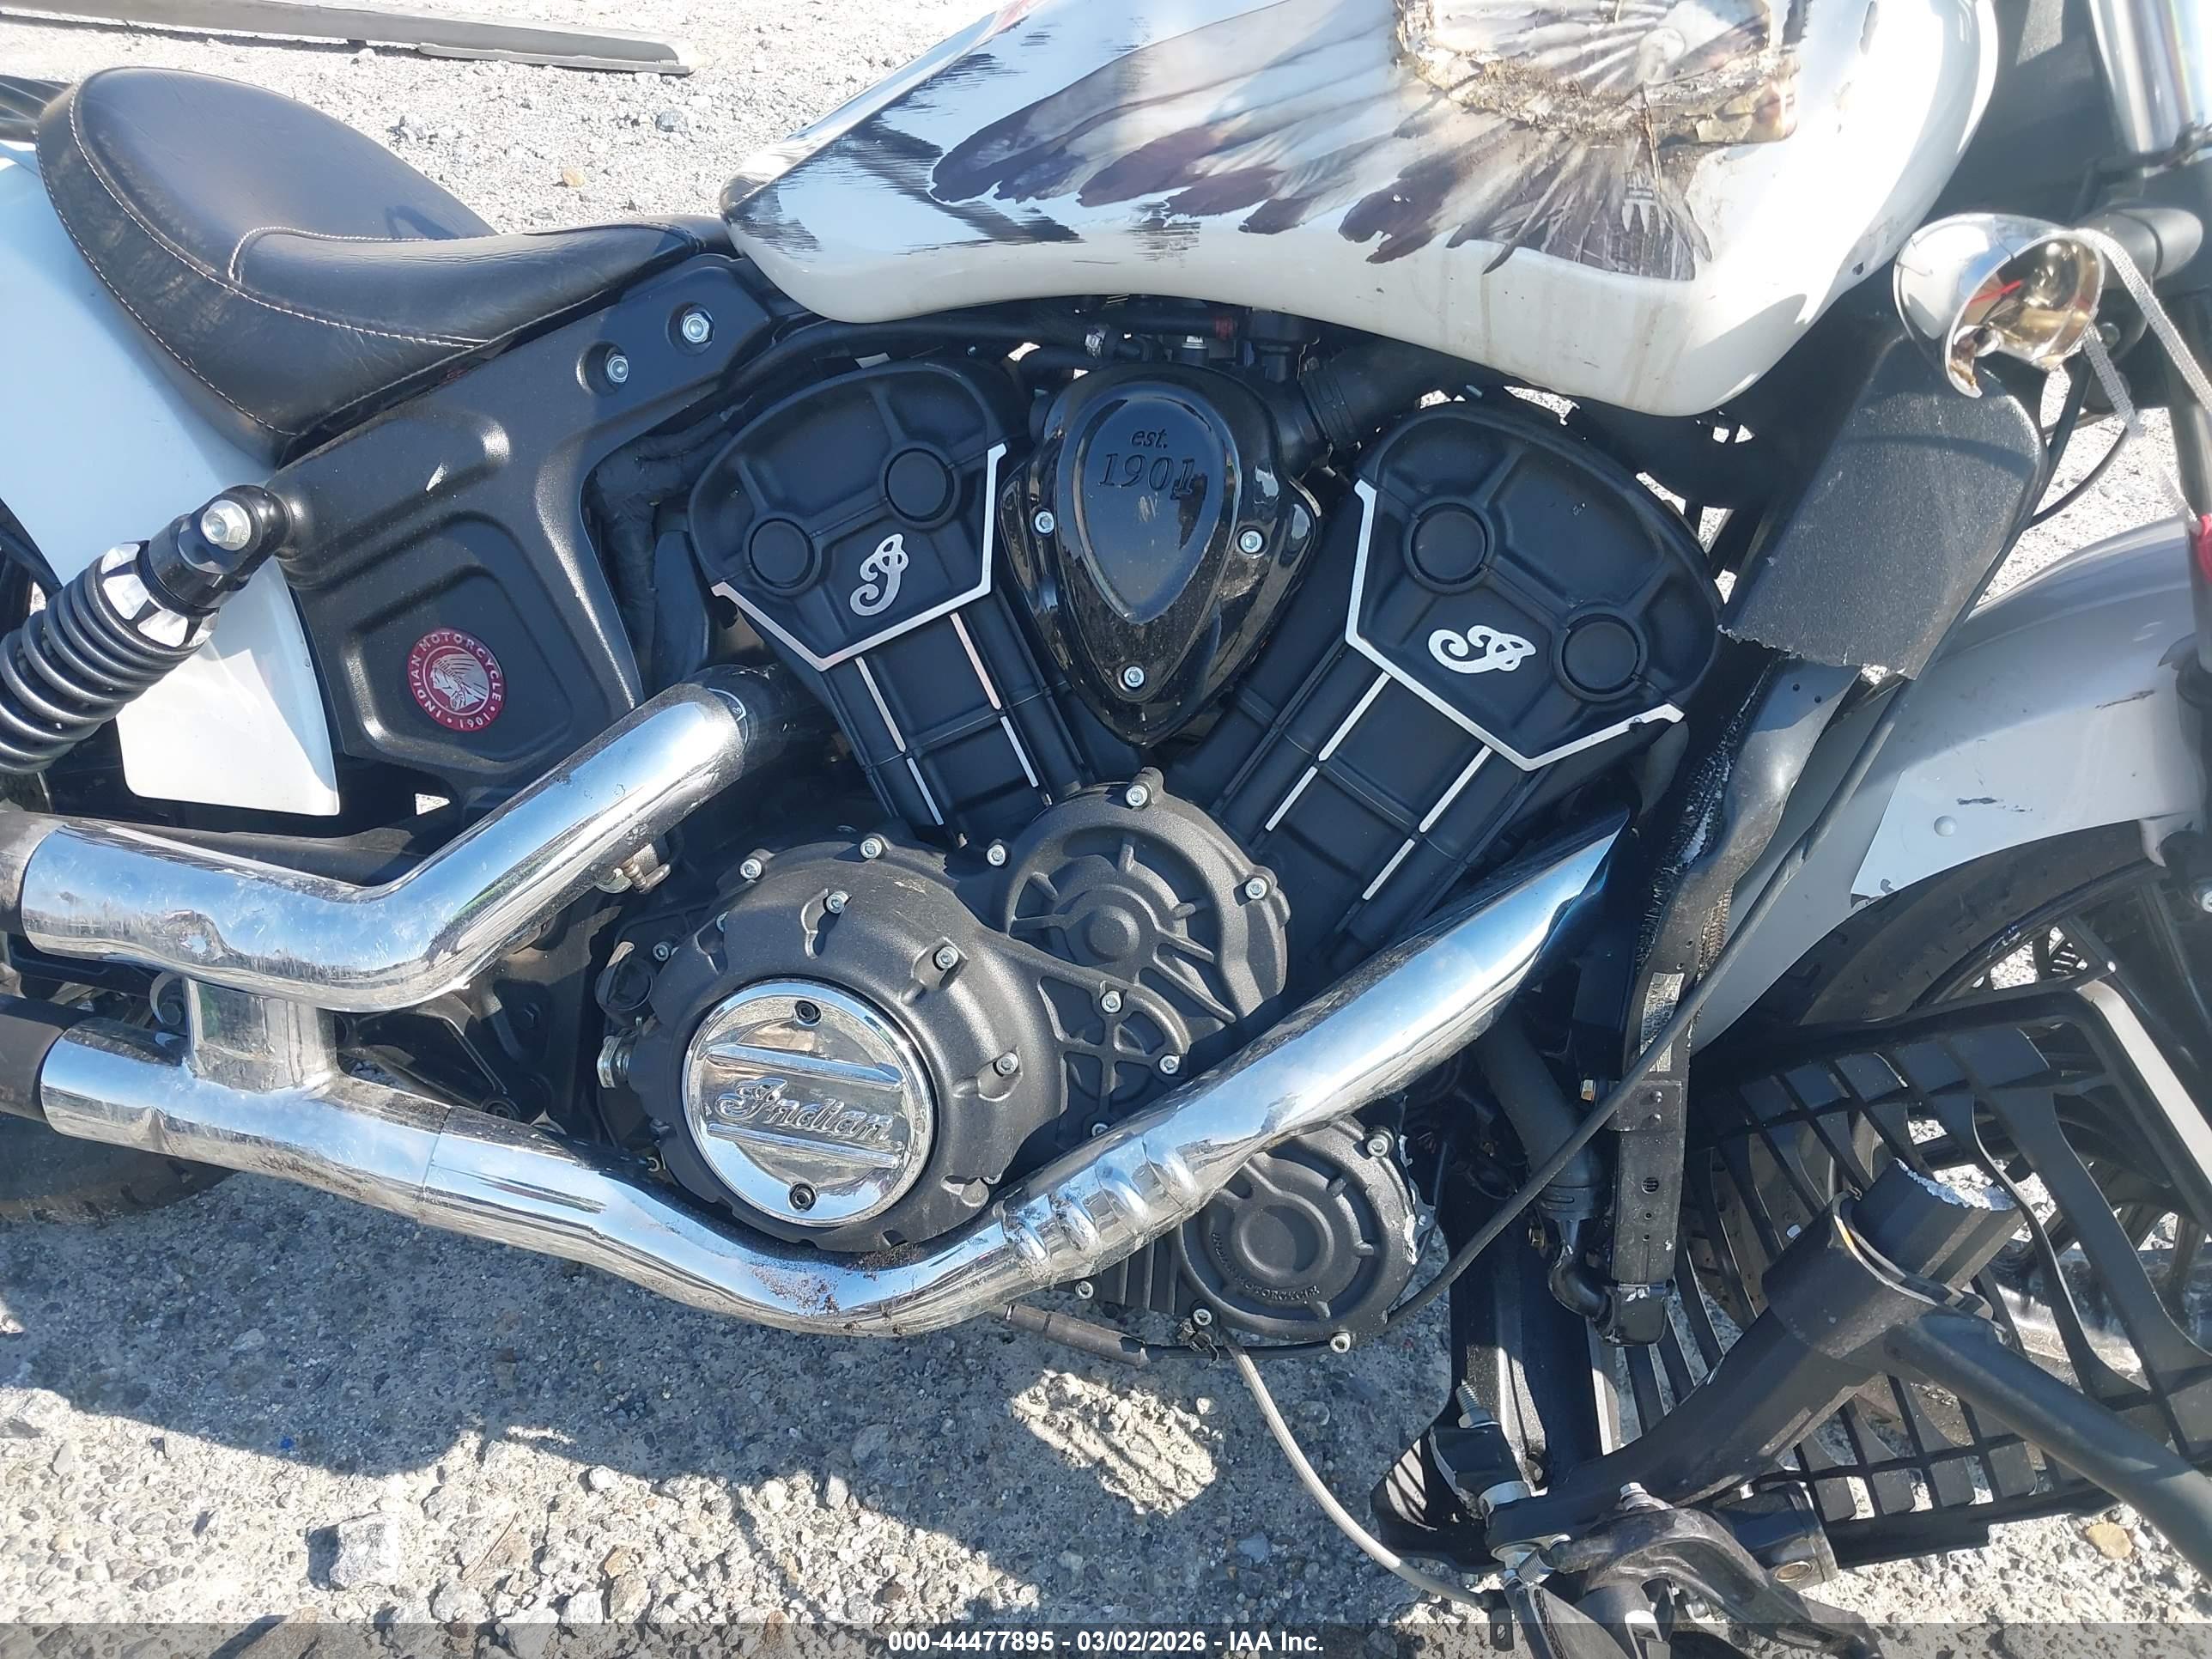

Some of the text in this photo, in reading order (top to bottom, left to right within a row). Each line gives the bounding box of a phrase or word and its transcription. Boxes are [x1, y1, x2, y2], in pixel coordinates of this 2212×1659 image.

[1131, 428, 1168, 449] est.
[1099, 453, 1195, 499] 1901
[410, 655, 441, 718] INDIAN
[419, 633, 502, 702] MOTORCYCLE
[714, 1077, 894, 1141] Indian
